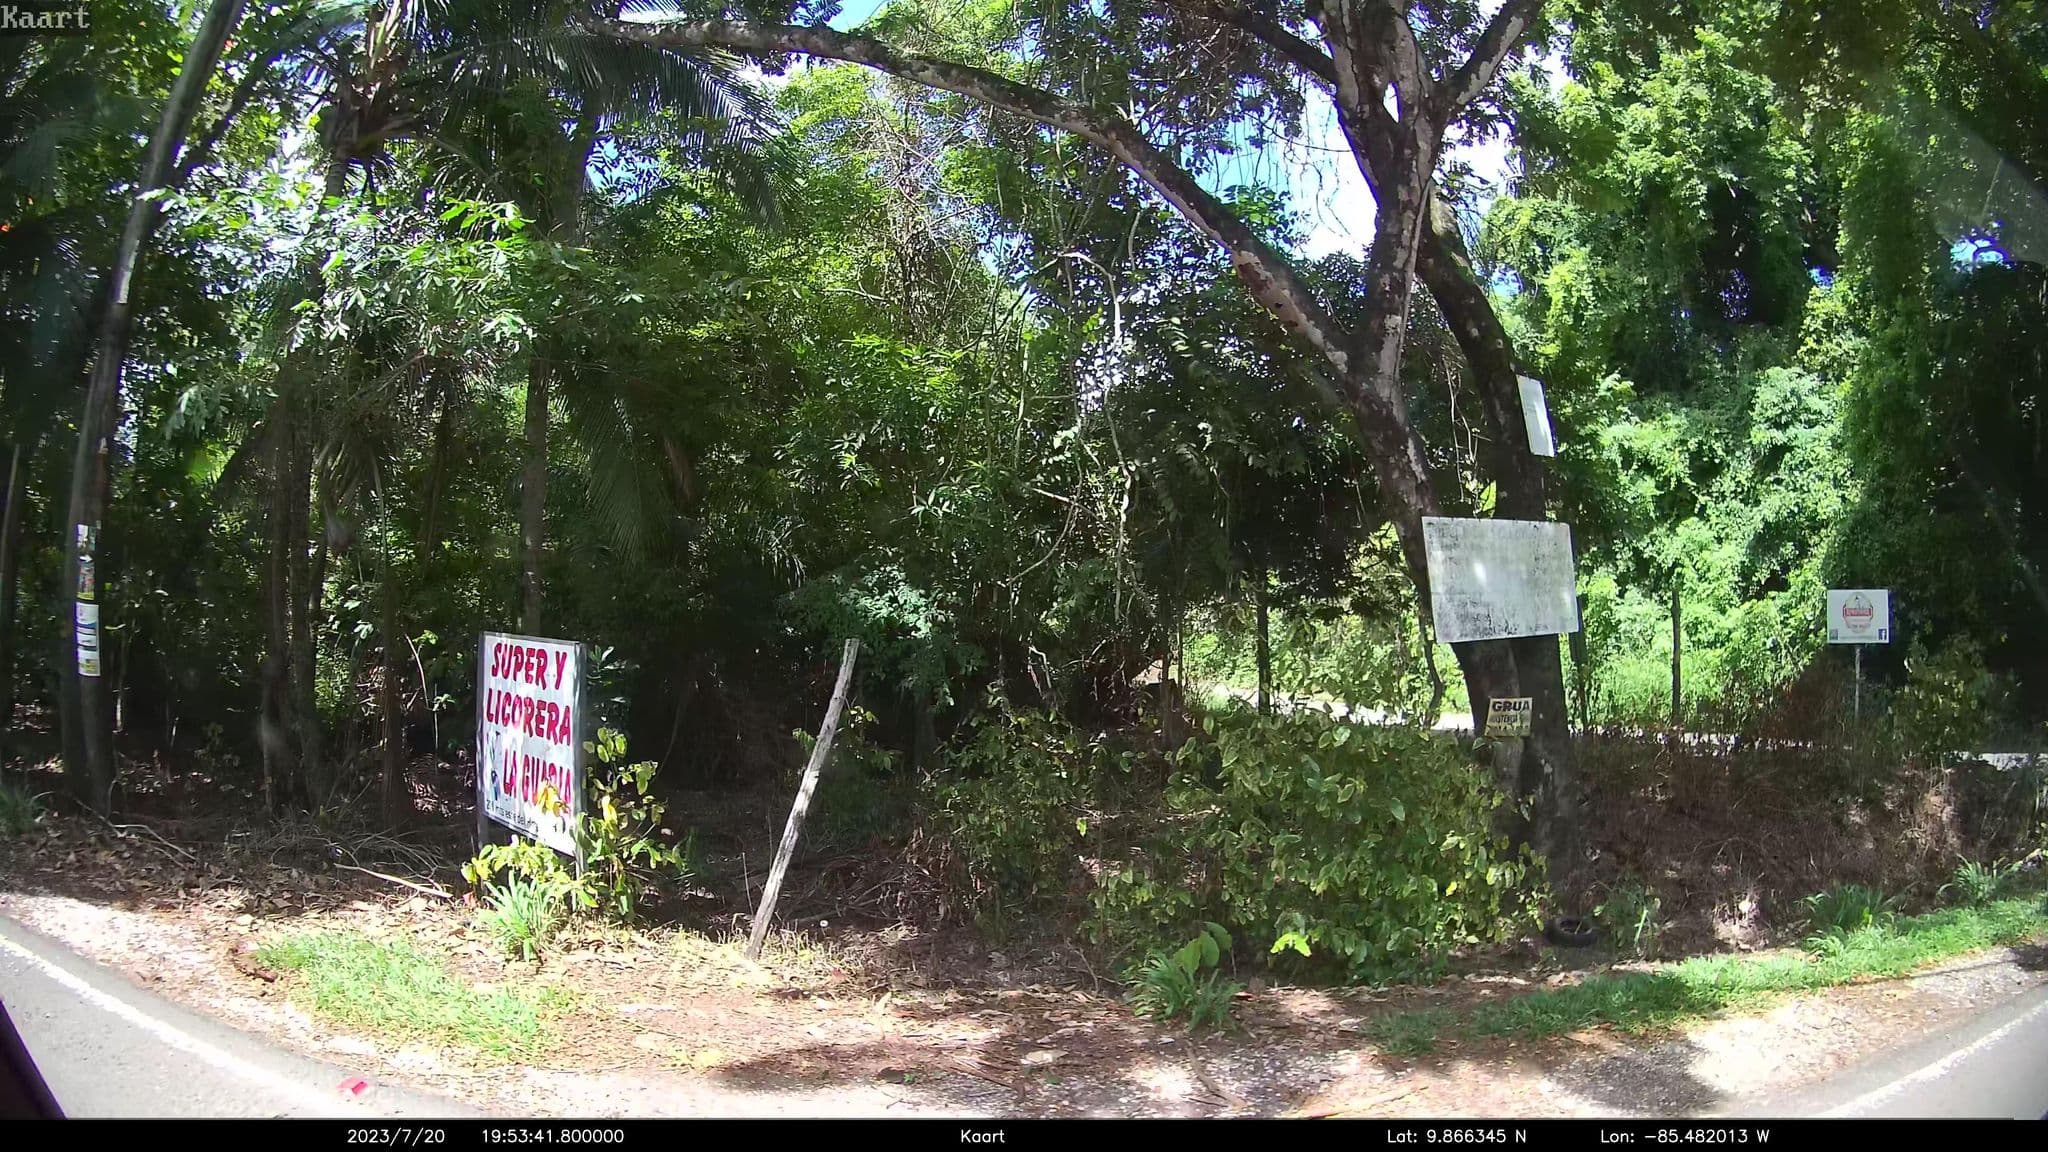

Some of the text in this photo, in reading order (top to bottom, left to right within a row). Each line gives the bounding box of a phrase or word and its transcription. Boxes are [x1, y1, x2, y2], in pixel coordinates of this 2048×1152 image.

[491, 643, 567, 690] SUPER Y
[486, 688, 571, 746] LICORERA
[1493, 701, 1530, 712] GRUA
[503, 749, 517, 799] LA
